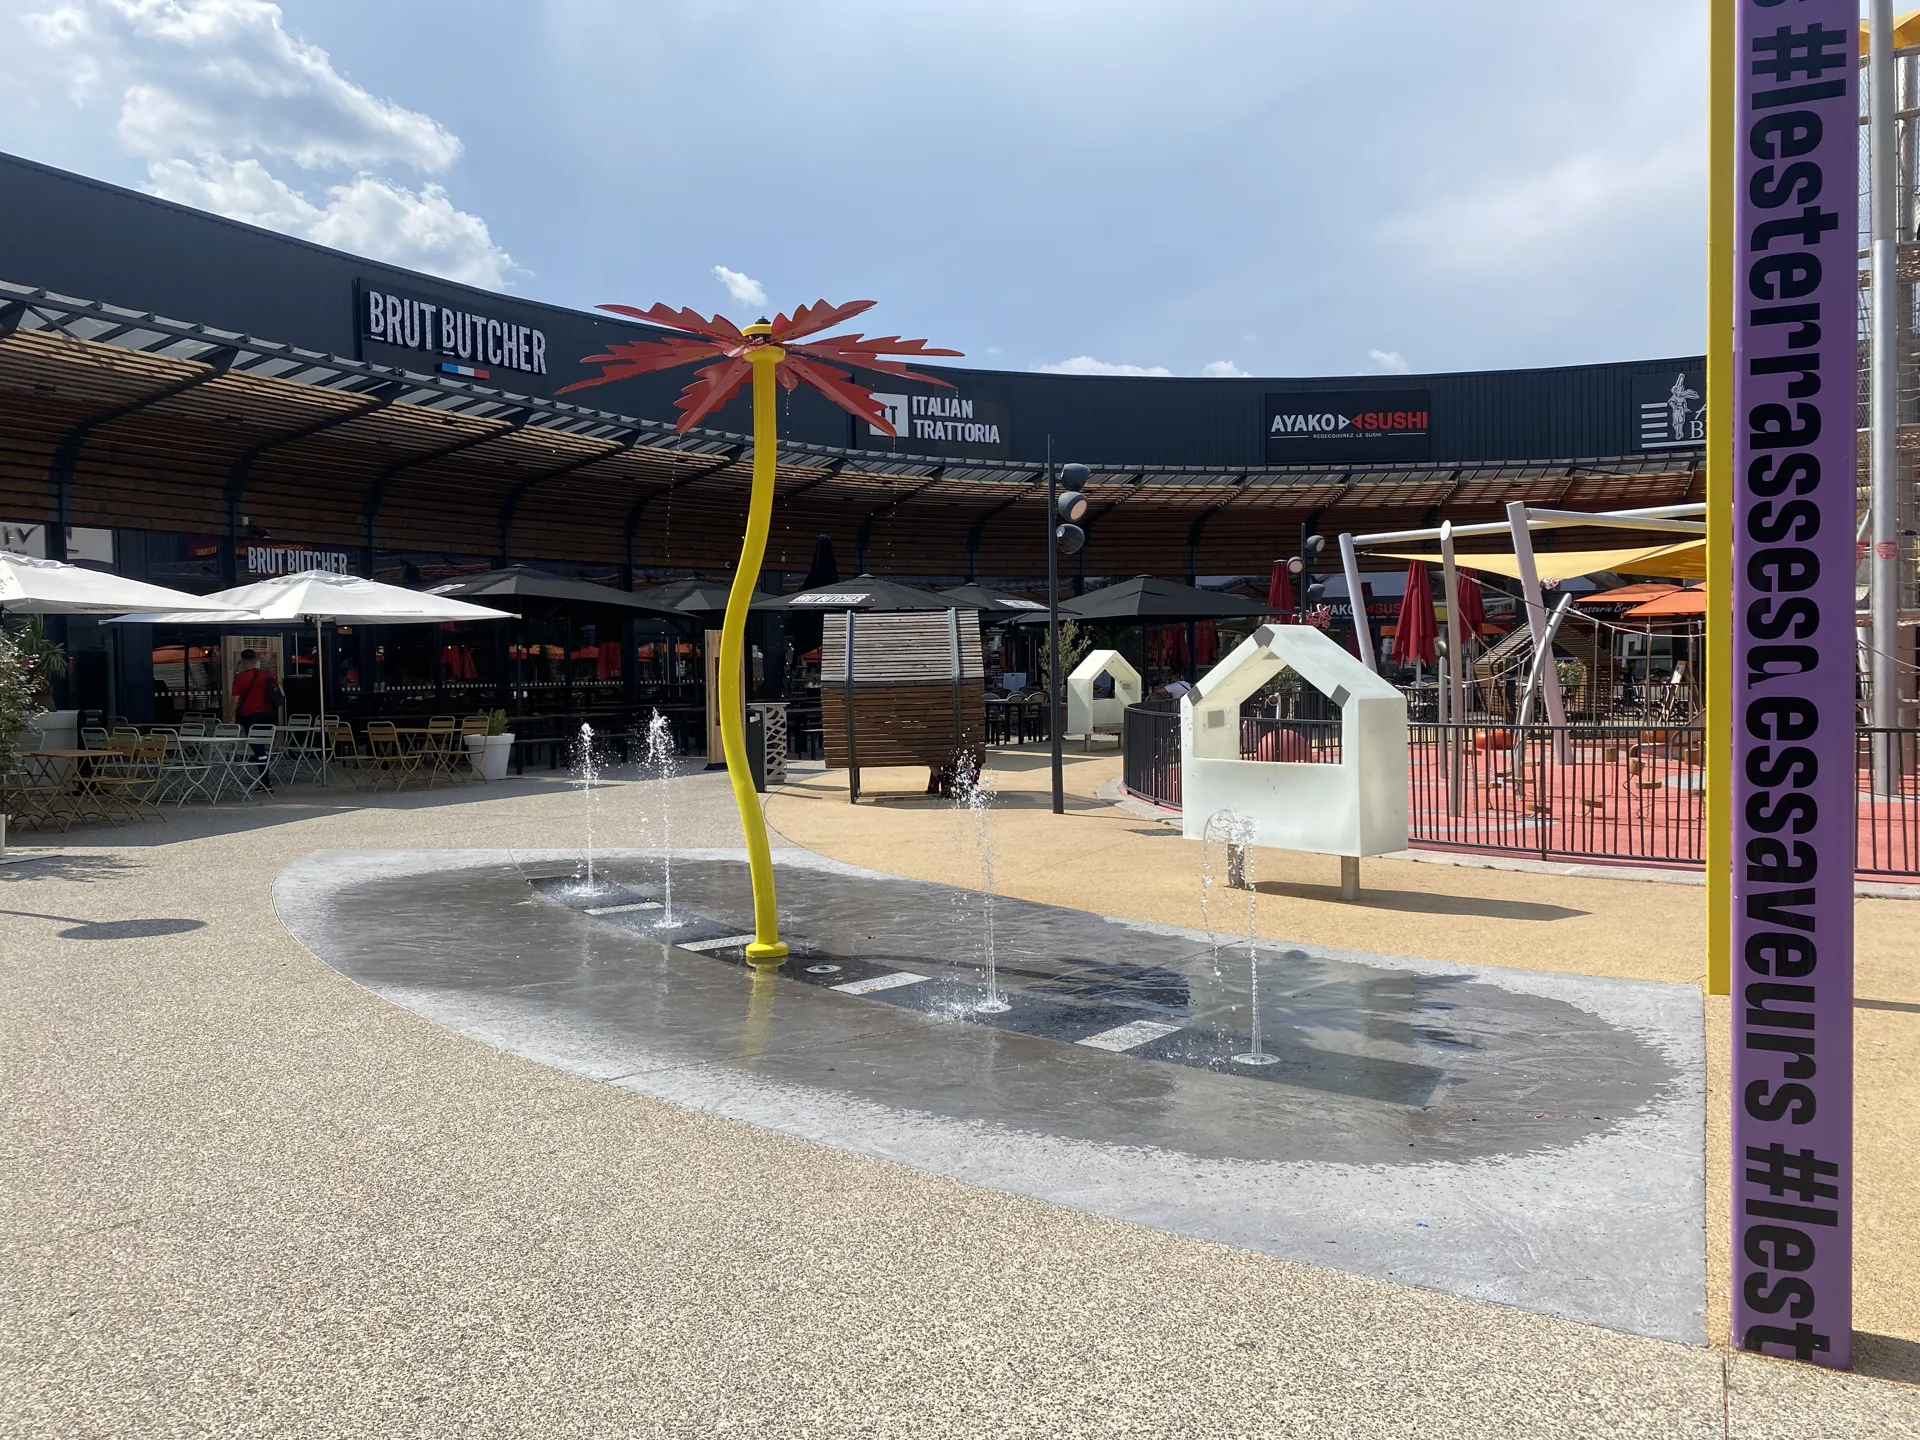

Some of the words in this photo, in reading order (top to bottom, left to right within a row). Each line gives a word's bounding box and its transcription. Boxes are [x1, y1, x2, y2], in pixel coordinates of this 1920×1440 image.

[369, 290, 436, 350] BRUT
[441, 307, 547, 374] BUTCHER
[911, 395, 974, 419] ITALIAN
[912, 419, 1001, 444] TRATTORIA
[1270, 413, 1336, 433] AYAKO
[1363, 411, 1428, 430] SUSHI
[247, 546, 285, 575] BRUT
[287, 549, 348, 575] BUTCHER
[1570, 602, 1613, 613] Brasserie
[1743, 1143, 1839, 1361] #lest
